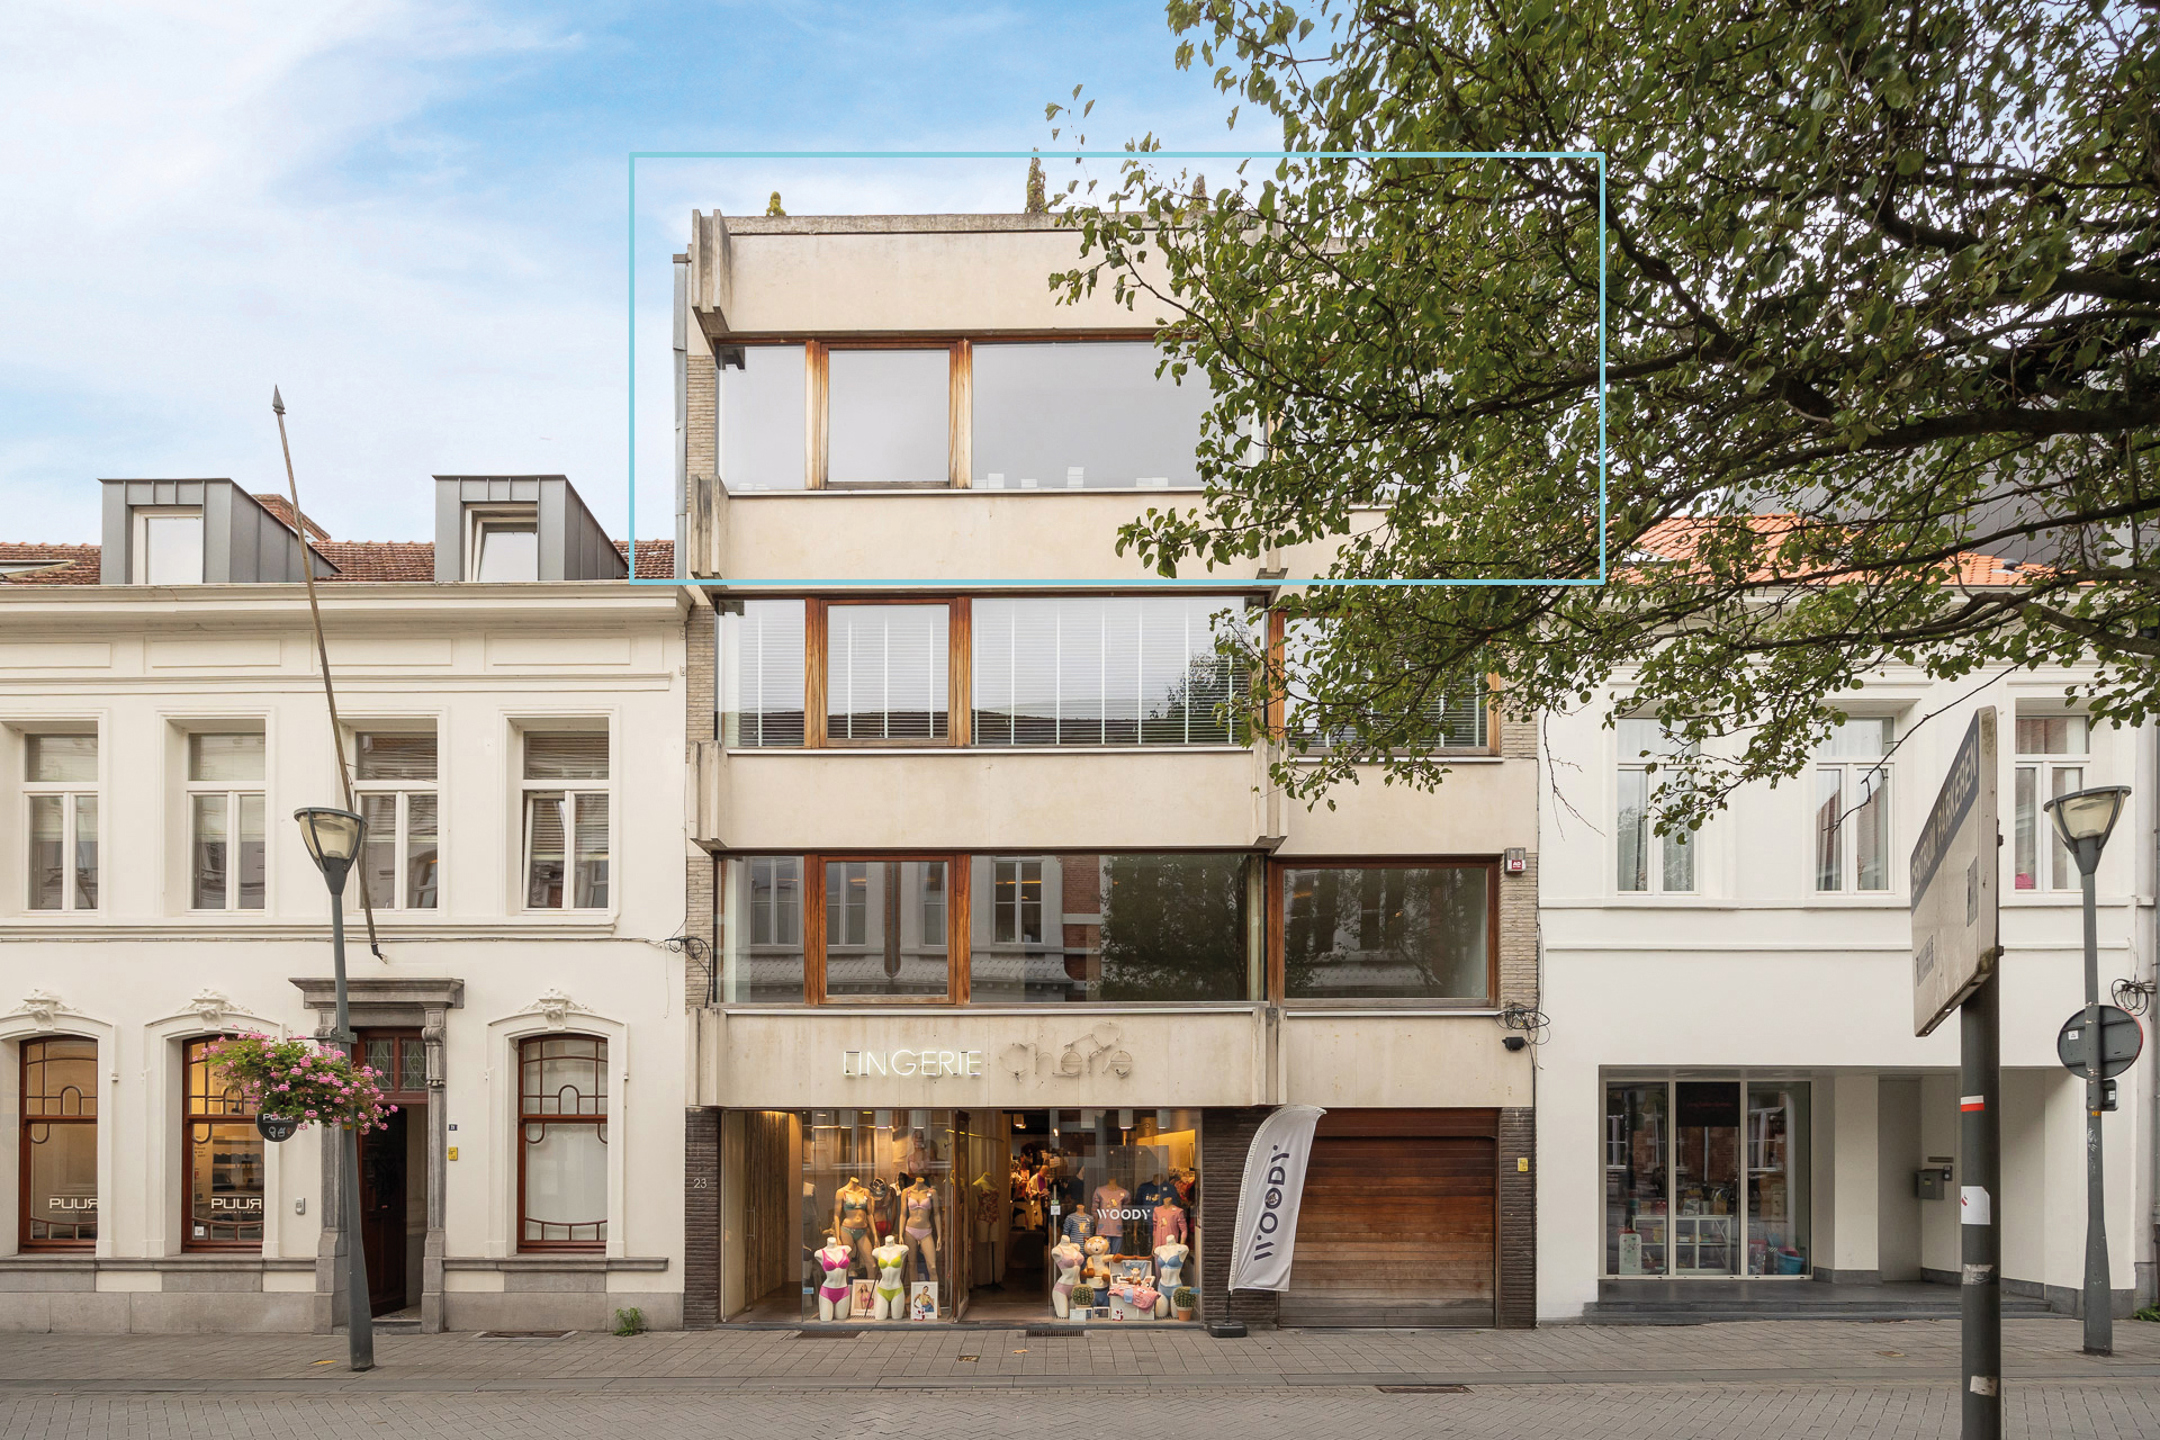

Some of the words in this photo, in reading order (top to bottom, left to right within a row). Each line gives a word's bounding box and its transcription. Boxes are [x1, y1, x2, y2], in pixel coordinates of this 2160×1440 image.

[1936, 733, 1977, 847] PARKEREN
[842, 1049, 983, 1077] LINGERIE
[693, 1177, 708, 1189] 23
[48, 1197, 98, 1209] PUUR
[210, 1197, 262, 1209] PUUR
[1253, 1144, 1290, 1261] WOODY
[1096, 1208, 1151, 1221] WOODY
